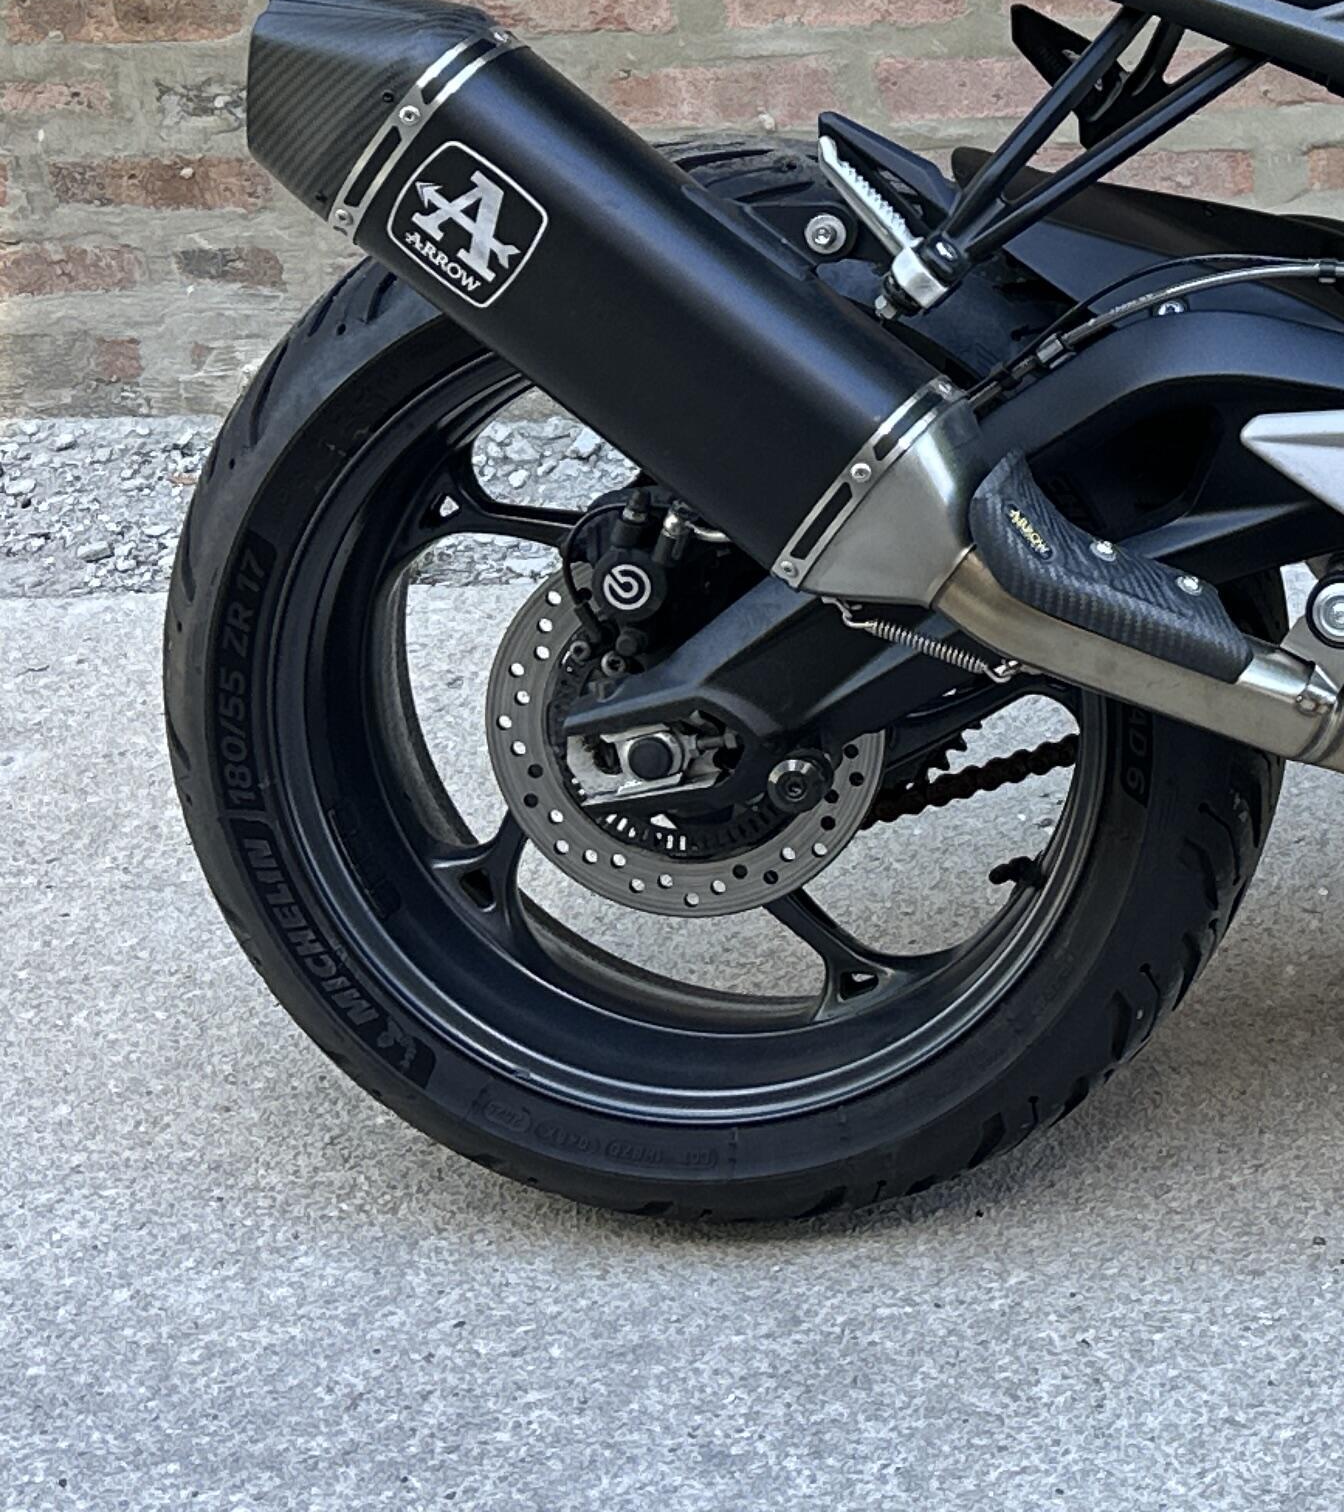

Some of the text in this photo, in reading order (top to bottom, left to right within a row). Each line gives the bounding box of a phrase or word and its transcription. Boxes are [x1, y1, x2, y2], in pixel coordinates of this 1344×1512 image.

[404, 231, 482, 292] ARROW
[219, 548, 378, 1029] MICHELIN 180/55 ZR 17
